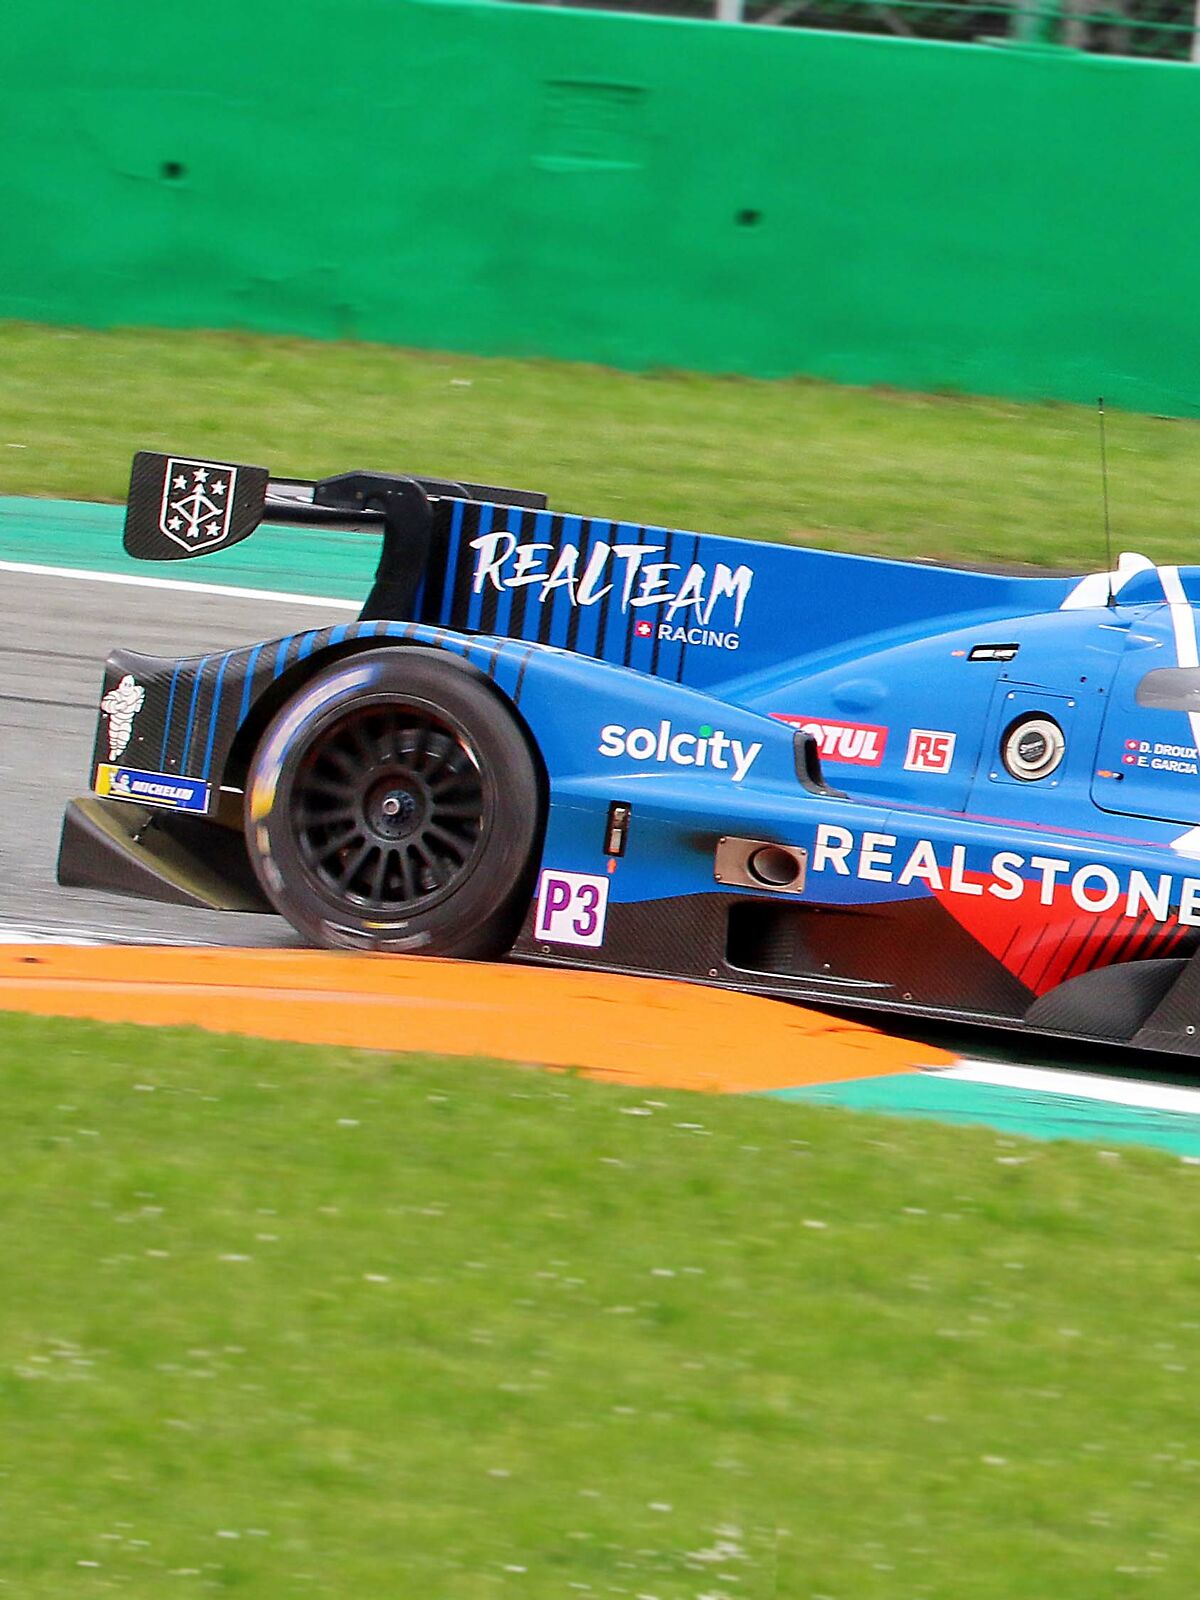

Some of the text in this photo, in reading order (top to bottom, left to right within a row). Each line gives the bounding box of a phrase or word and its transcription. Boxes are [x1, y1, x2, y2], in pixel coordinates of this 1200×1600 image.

[657, 624, 740, 649] RACING
[598, 720, 763, 782] solcity
[784, 720, 879, 760] OTUL
[911, 735, 950, 768] RS
[1139, 742, 1198, 759] D. DROUX
[1151, 758, 1198, 775] GARCIA
[131, 781, 194, 800] MICHELIN
[542, 879, 600, 936] P3
